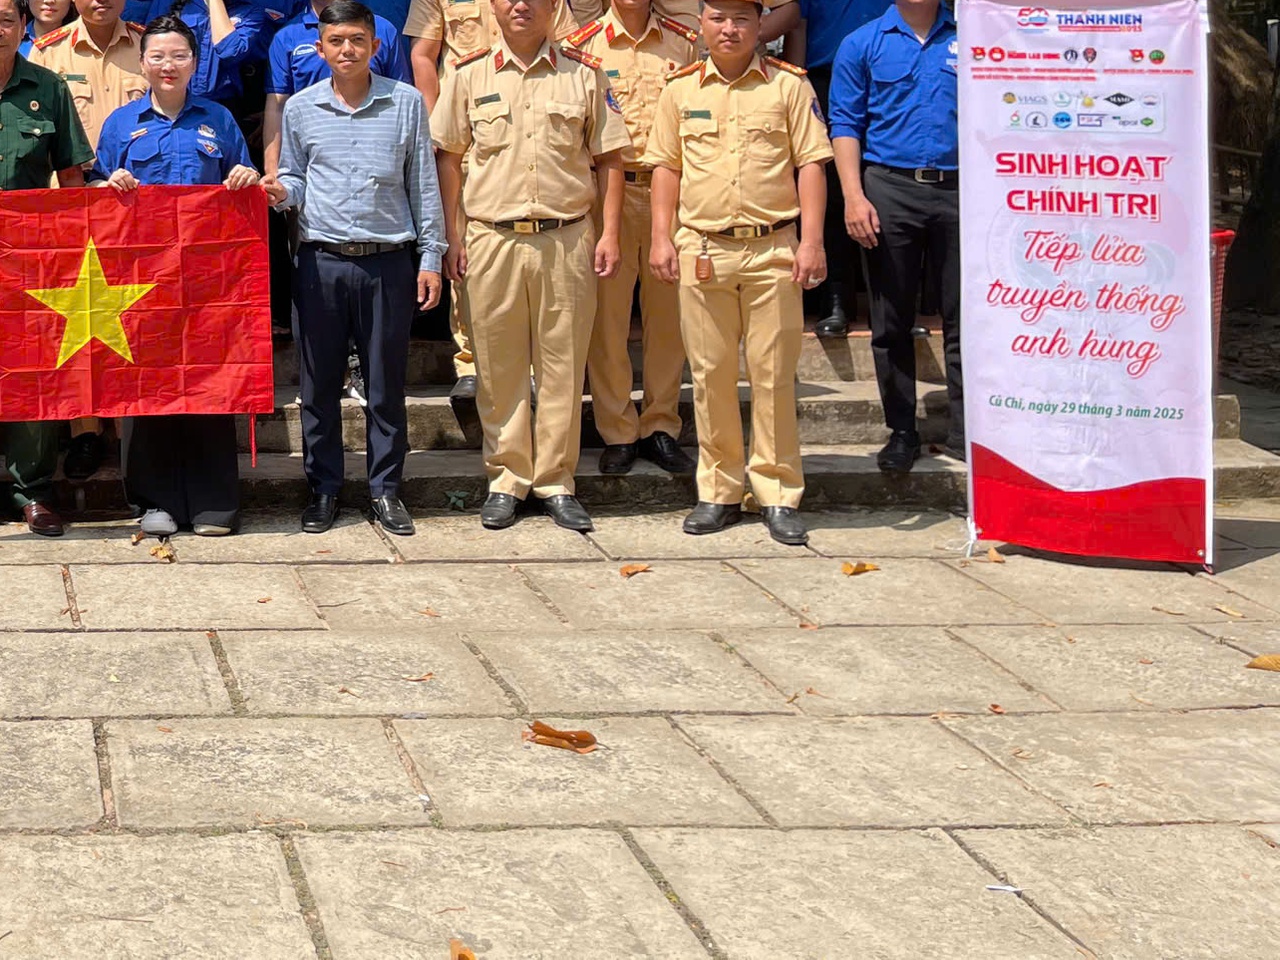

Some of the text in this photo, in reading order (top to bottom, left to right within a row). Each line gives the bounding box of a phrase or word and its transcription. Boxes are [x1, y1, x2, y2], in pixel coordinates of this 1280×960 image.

[995, 151, 1167, 182] SINH HOẠT
[1006, 186, 1158, 221] CHÍNH TRỊ
[1023, 230, 1143, 272] Tiếp lửa
[986, 278, 1182, 328] truyền thống
[1011, 328, 1159, 374] anh hùng
[1028, 401, 1059, 414] ngày
[1060, 402, 1076, 414] 29
[1078, 402, 1113, 418] tháng
[1115, 405, 1123, 416] 3
[1125, 406, 1151, 418] năm
[1153, 407, 1185, 420] 2025
